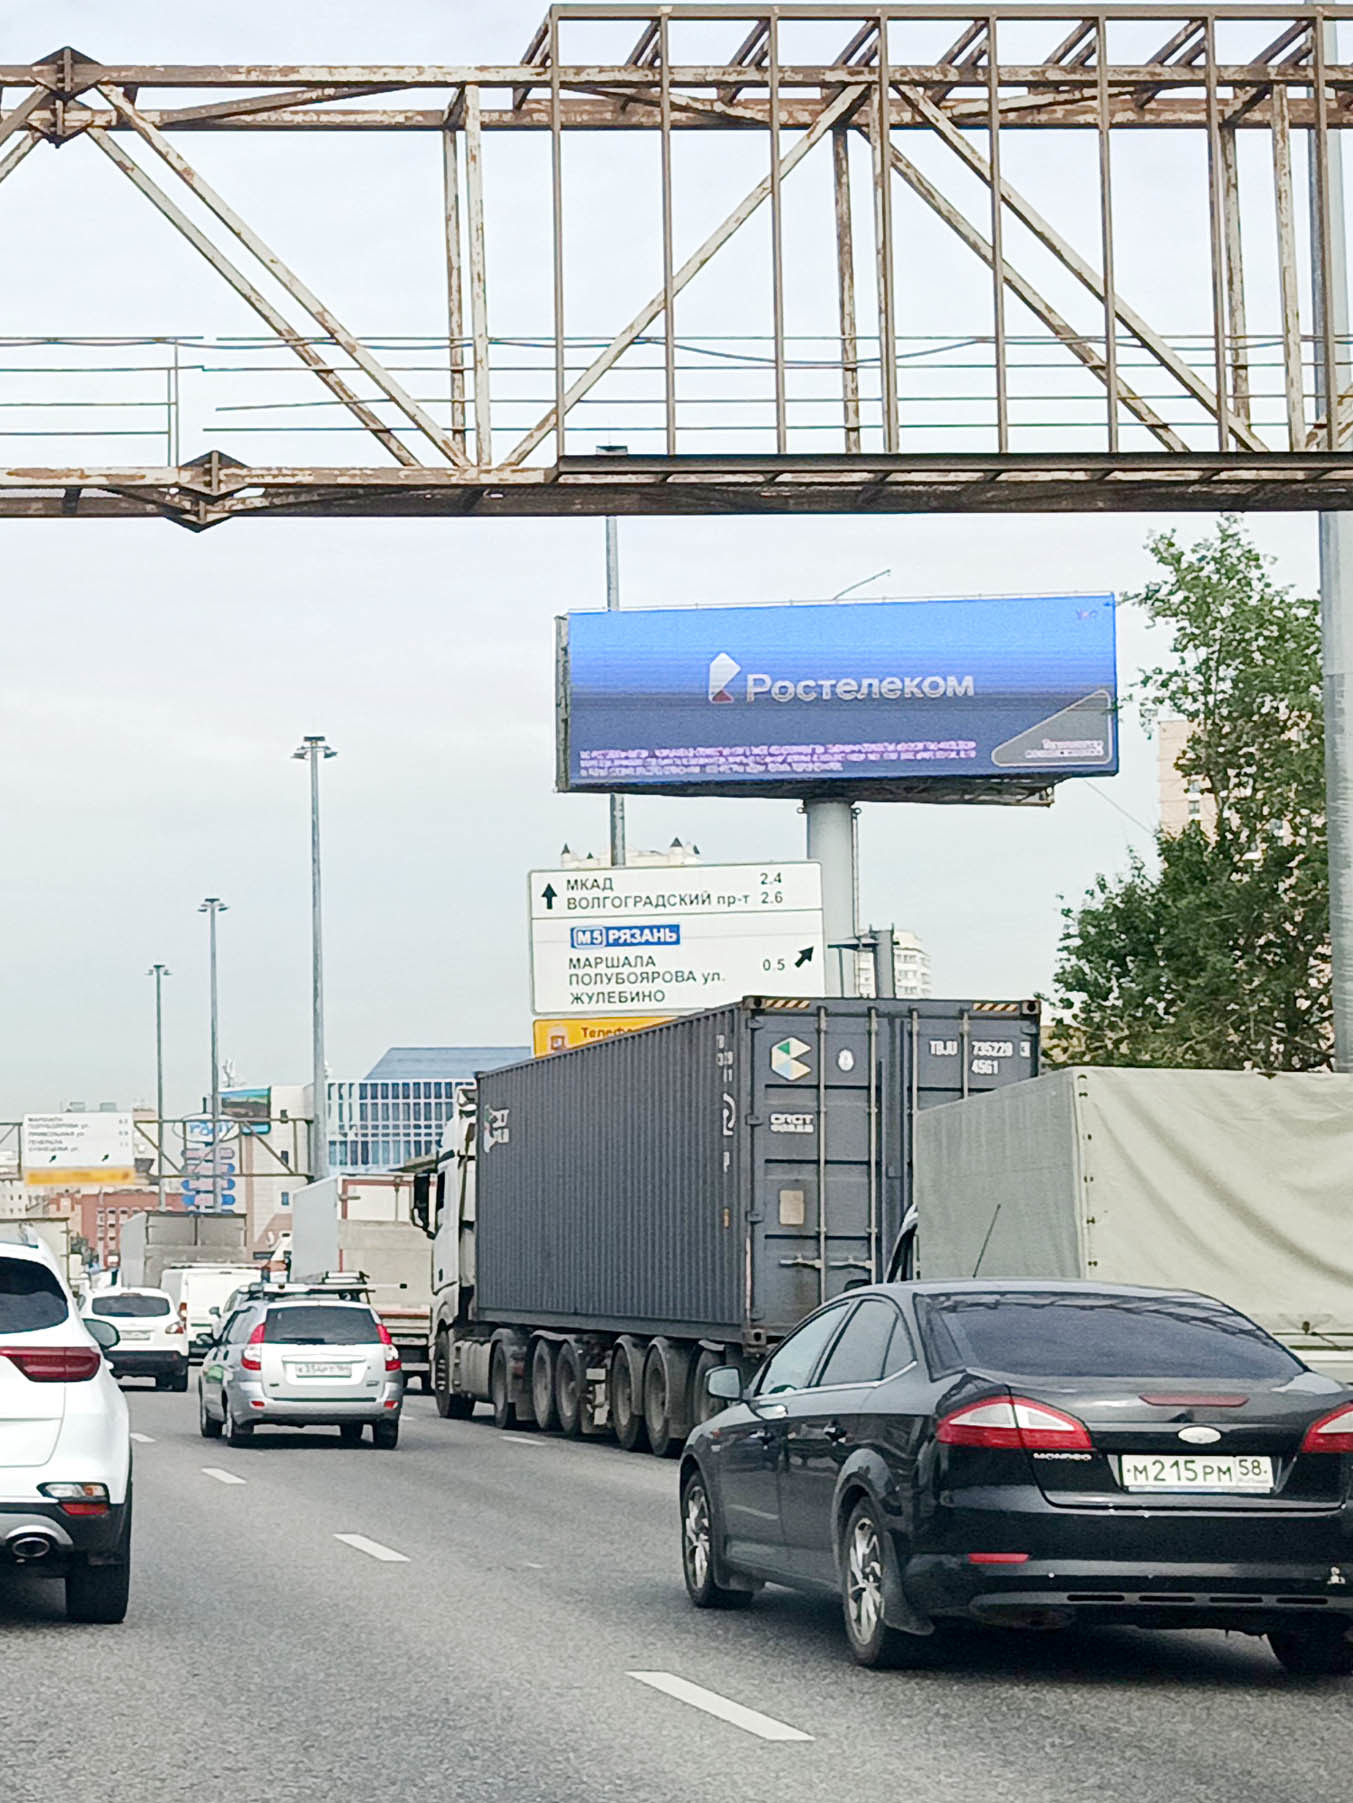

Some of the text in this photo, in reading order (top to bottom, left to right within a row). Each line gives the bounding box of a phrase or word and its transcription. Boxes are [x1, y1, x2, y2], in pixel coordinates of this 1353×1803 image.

[746, 673, 976, 703] Ростелеком
[566, 877, 615, 892] МКАД
[567, 889, 751, 911] ВОЛГОГРАДСКИЙ пр-т
[607, 927, 678, 944] РЯЗАНЬ
[568, 955, 657, 970] МАРШАЛА
[568, 970, 698, 987] ПОЛУБОЯРОВА
[570, 989, 666, 1006] ЖУЛЕБИНО
